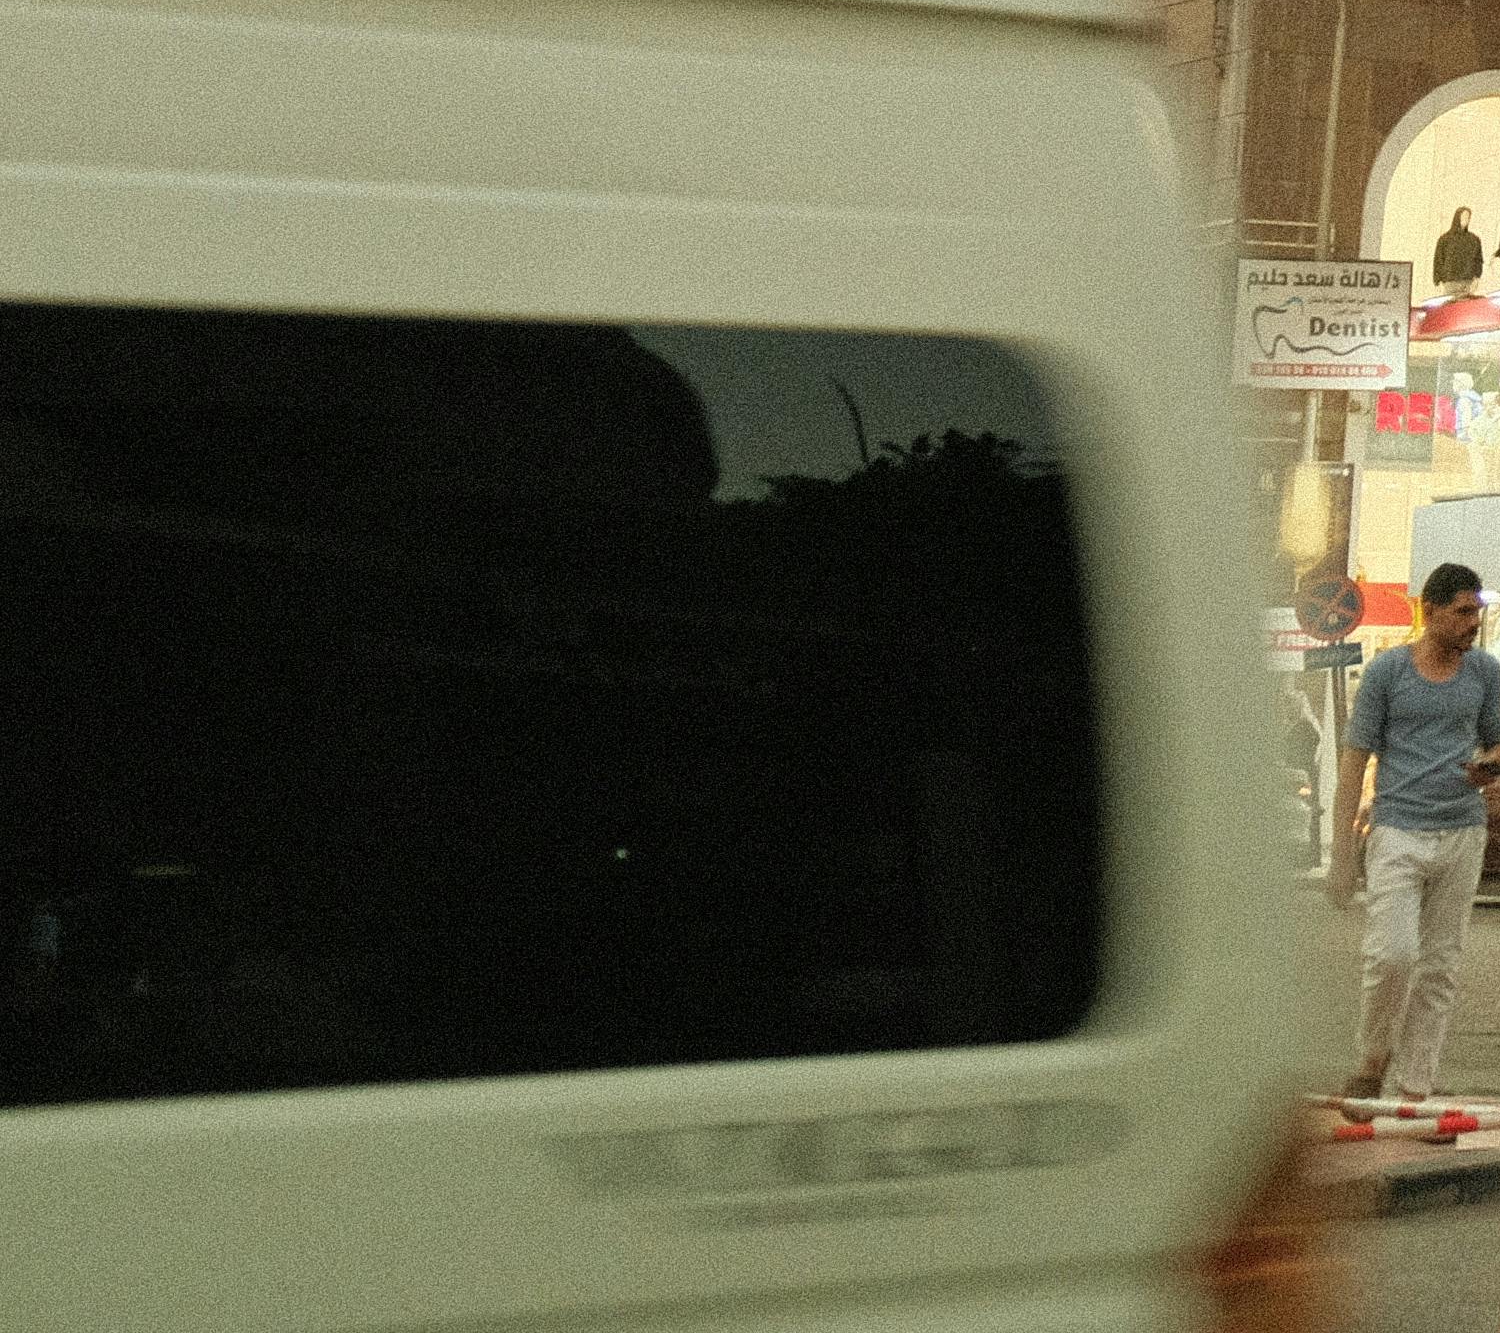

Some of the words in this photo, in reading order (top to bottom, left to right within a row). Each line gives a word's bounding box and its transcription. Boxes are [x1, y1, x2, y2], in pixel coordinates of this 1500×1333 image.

[1247, 267, 1289, 293] حليم
[1293, 270, 1334, 288] سعد
[1340, 267, 1382, 289] هالة
[1309, 316, 1402, 338] Dentist
